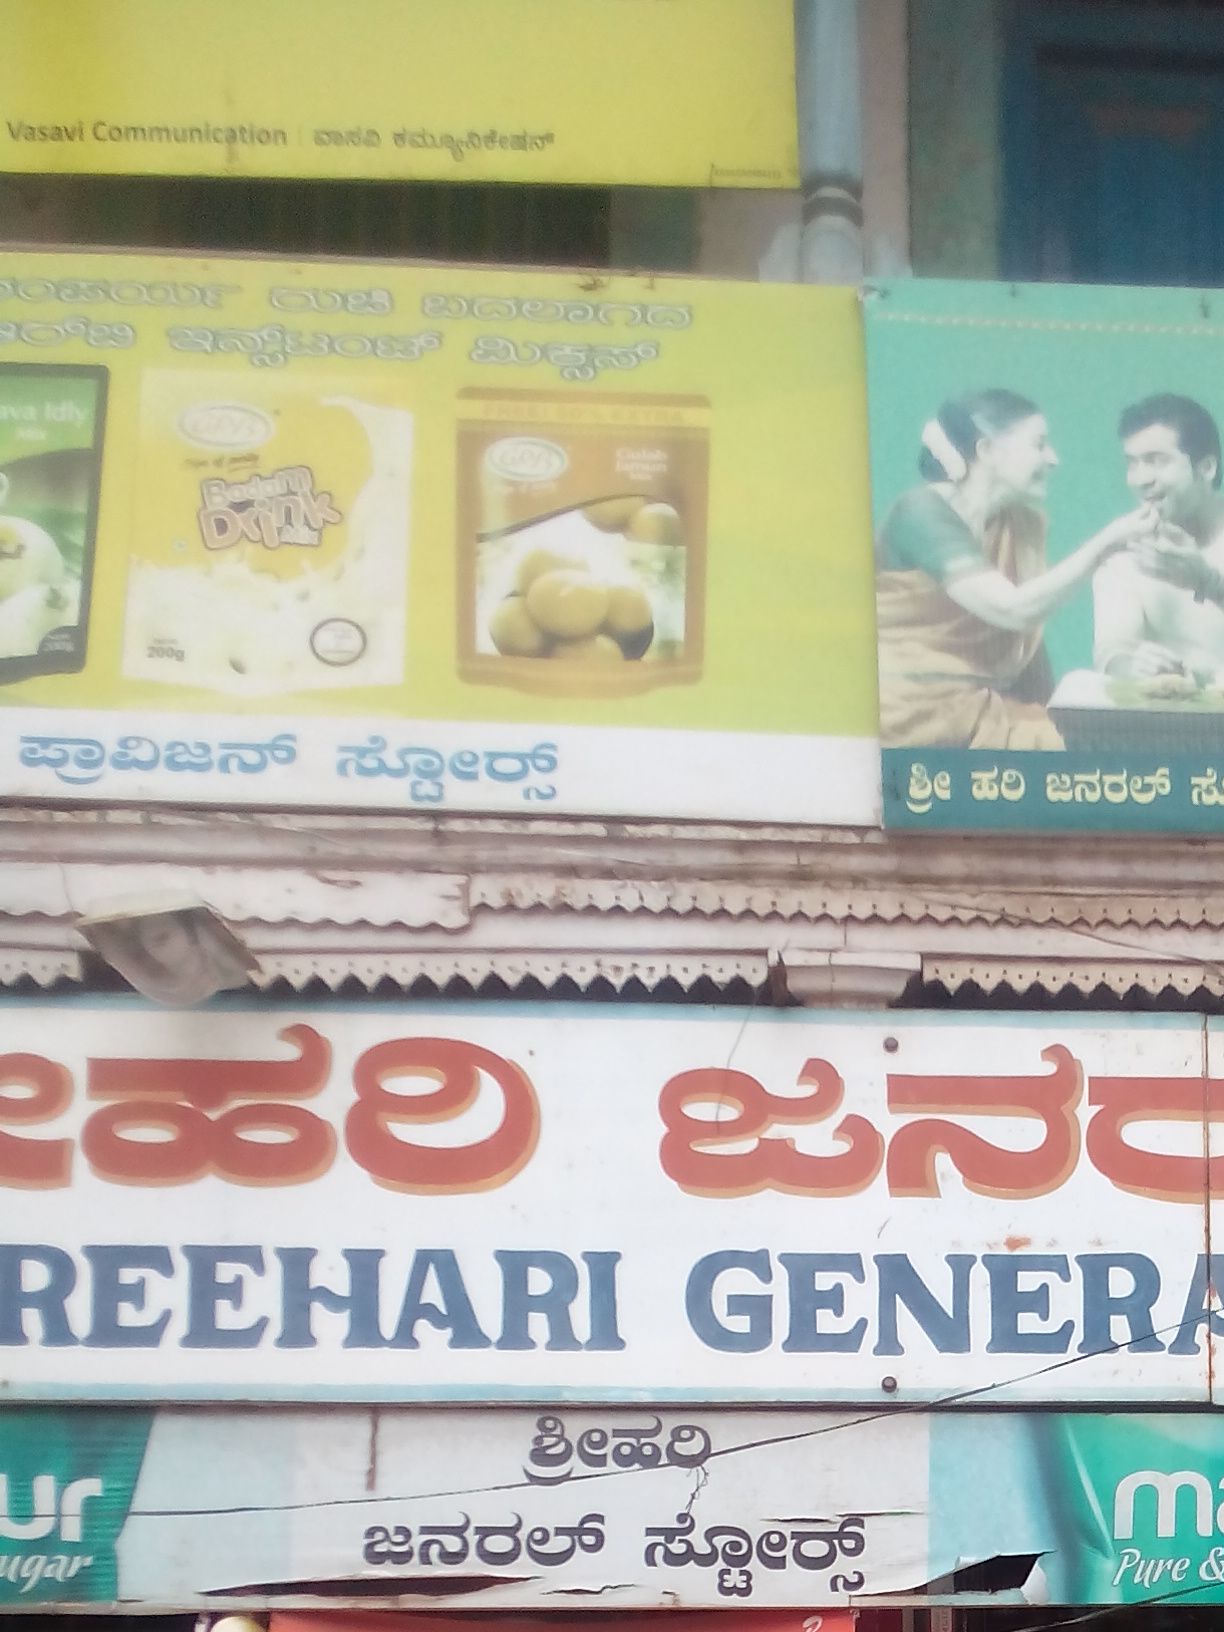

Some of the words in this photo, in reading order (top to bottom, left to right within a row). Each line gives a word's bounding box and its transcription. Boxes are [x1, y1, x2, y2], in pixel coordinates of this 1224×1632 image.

[6, 120, 84, 143] Vasavi
[92, 120, 288, 147] Communication
[906, 762, 951, 815] ಶ್ರೀ
[971, 766, 1026, 802] ಹರಿ
[1045, 767, 1171, 804] ಜನರಲ್
[521, 1414, 714, 1488] ಶ್ರೀಹರಿ
[363, 1509, 604, 1568] ಜನರಲ್
[1111, 1547, 1188, 1591] Pure
